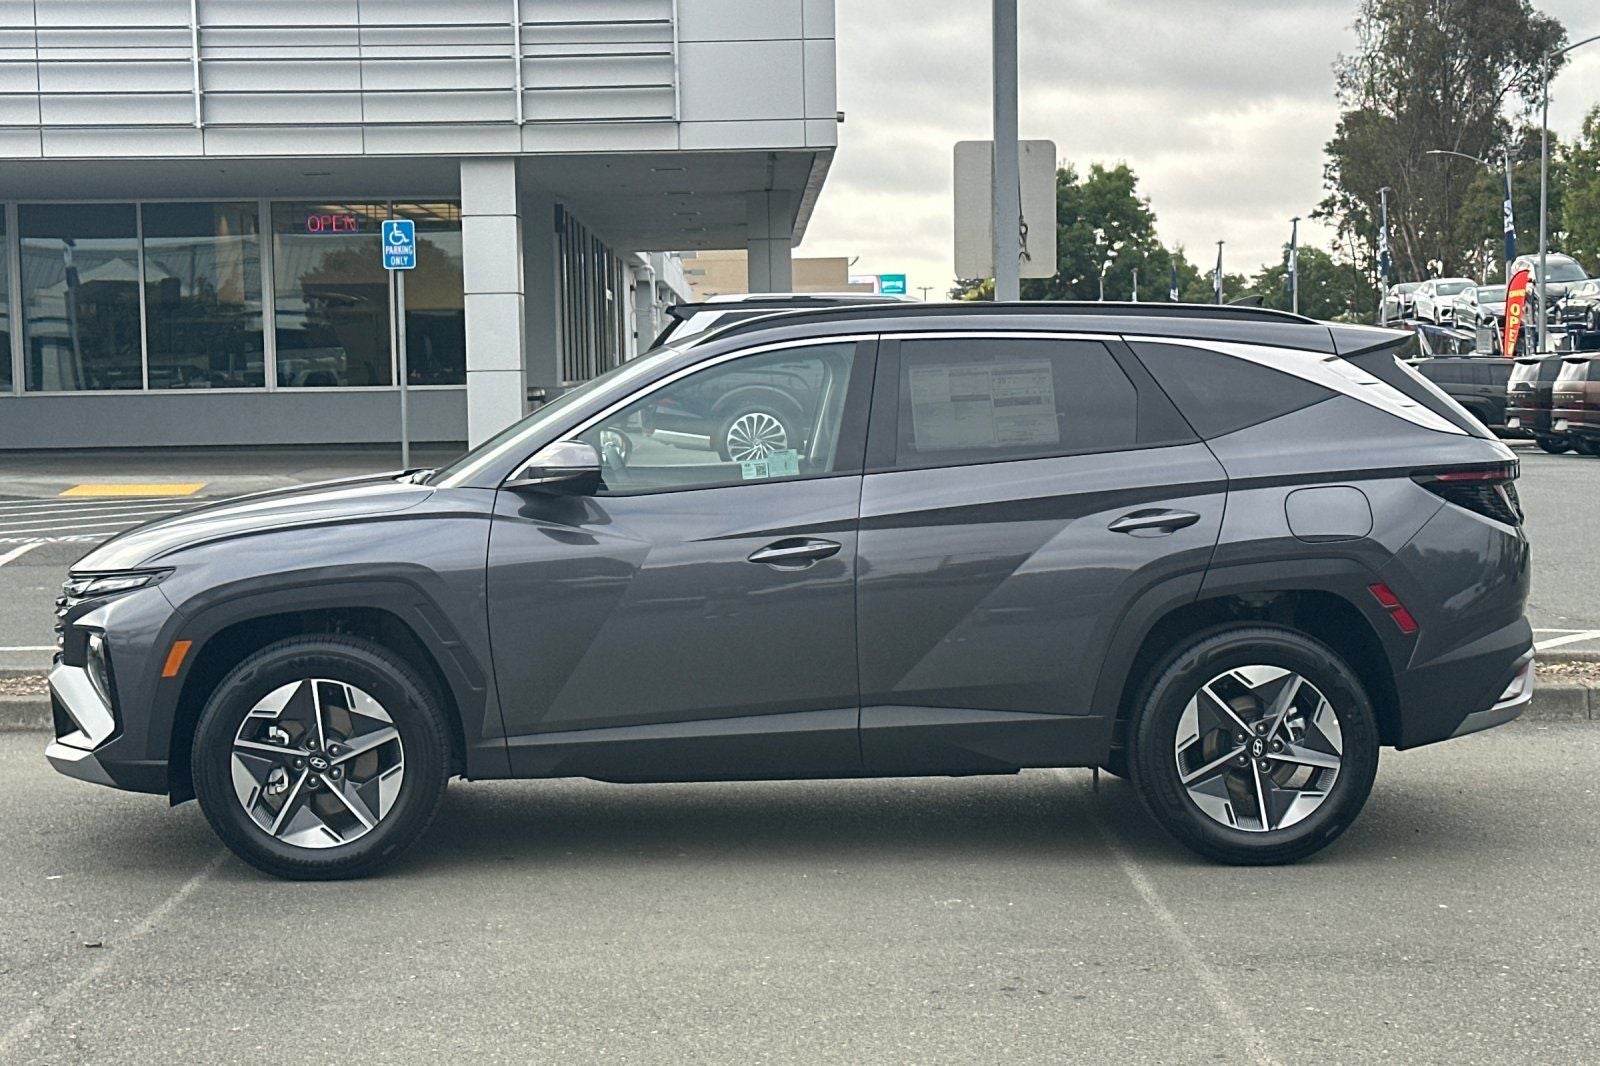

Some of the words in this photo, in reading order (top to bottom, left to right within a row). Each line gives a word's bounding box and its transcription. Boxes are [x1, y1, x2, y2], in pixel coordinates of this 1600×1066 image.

[307, 214, 358, 232] OPEN
[385, 245, 412, 254] PARKING
[391, 256, 408, 265] ONLY
